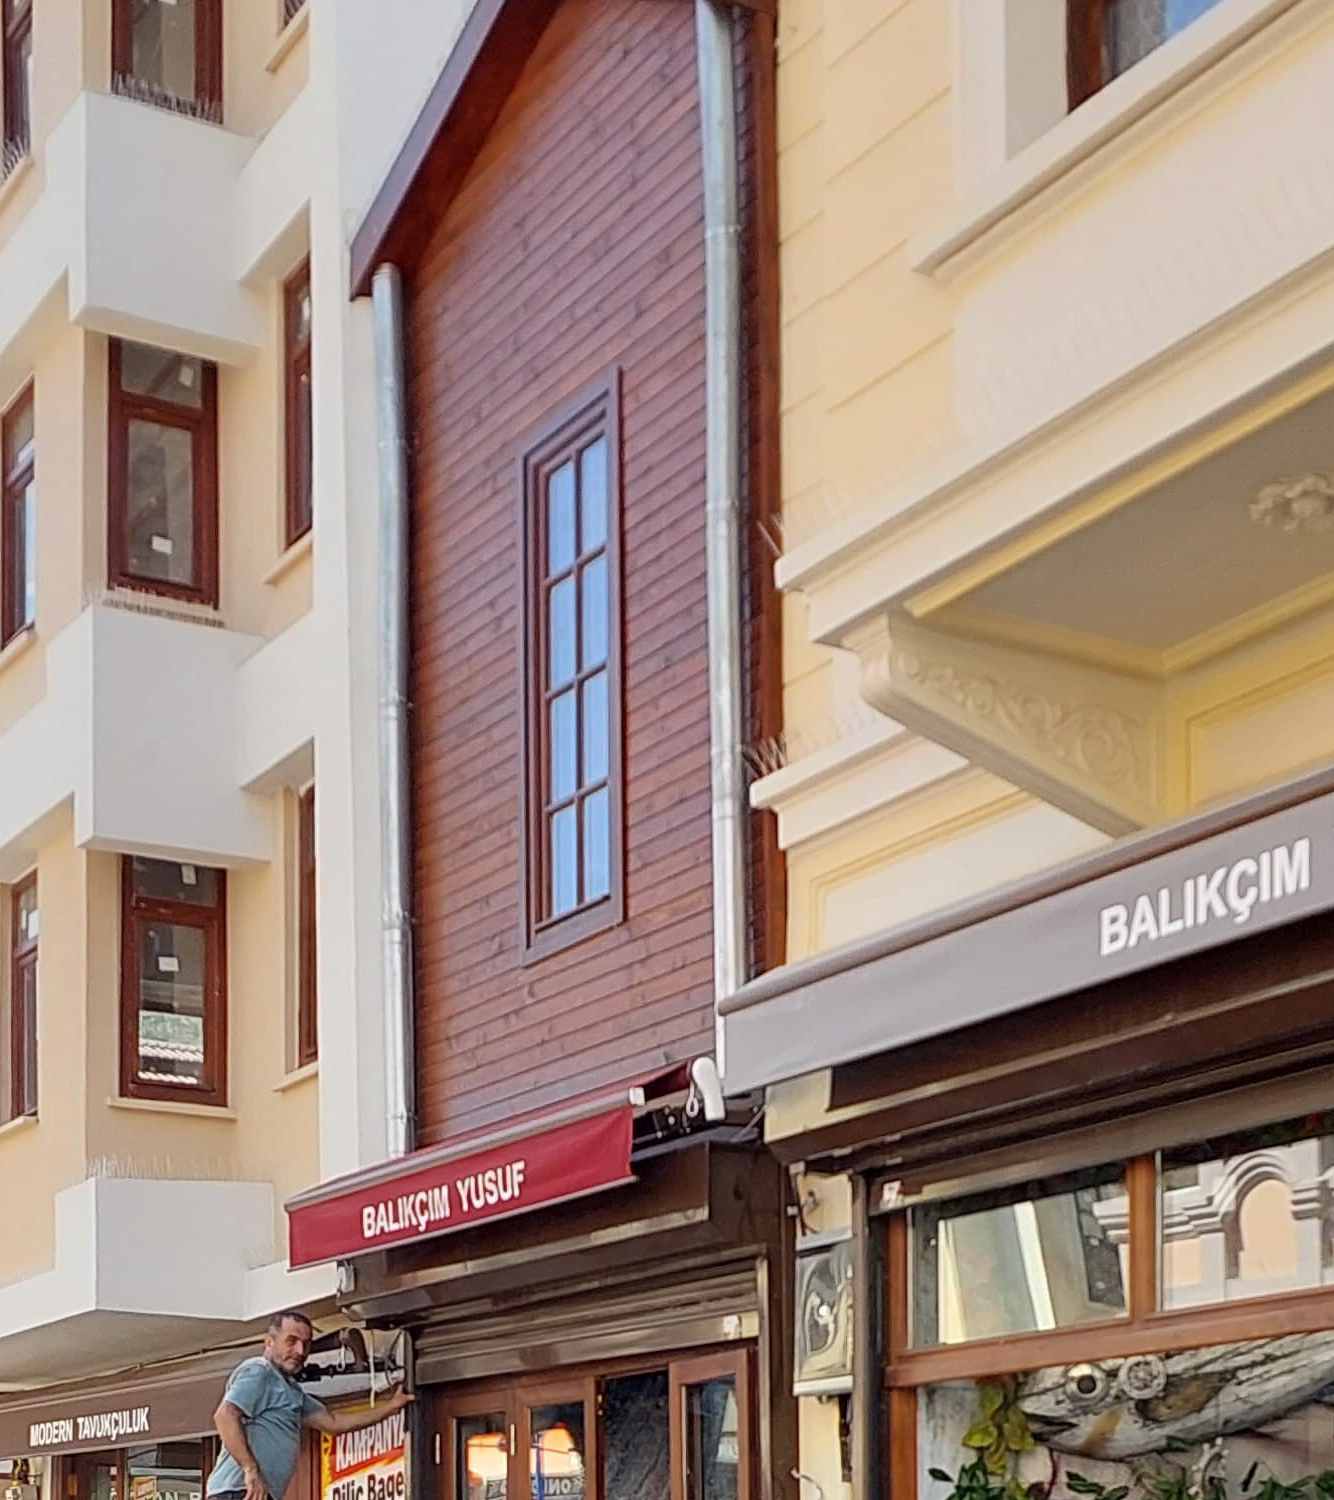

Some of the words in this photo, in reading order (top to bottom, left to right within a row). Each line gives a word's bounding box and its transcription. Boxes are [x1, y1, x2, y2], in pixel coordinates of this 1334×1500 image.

[1100, 838, 1311, 956] BALIKÇIM
[362, 1184, 450, 1238] BALIKÇIM
[456, 1160, 526, 1212] YUSUF
[29, 1419, 73, 1447] MODERN
[77, 1406, 150, 1441] TAVUKÇULUK
